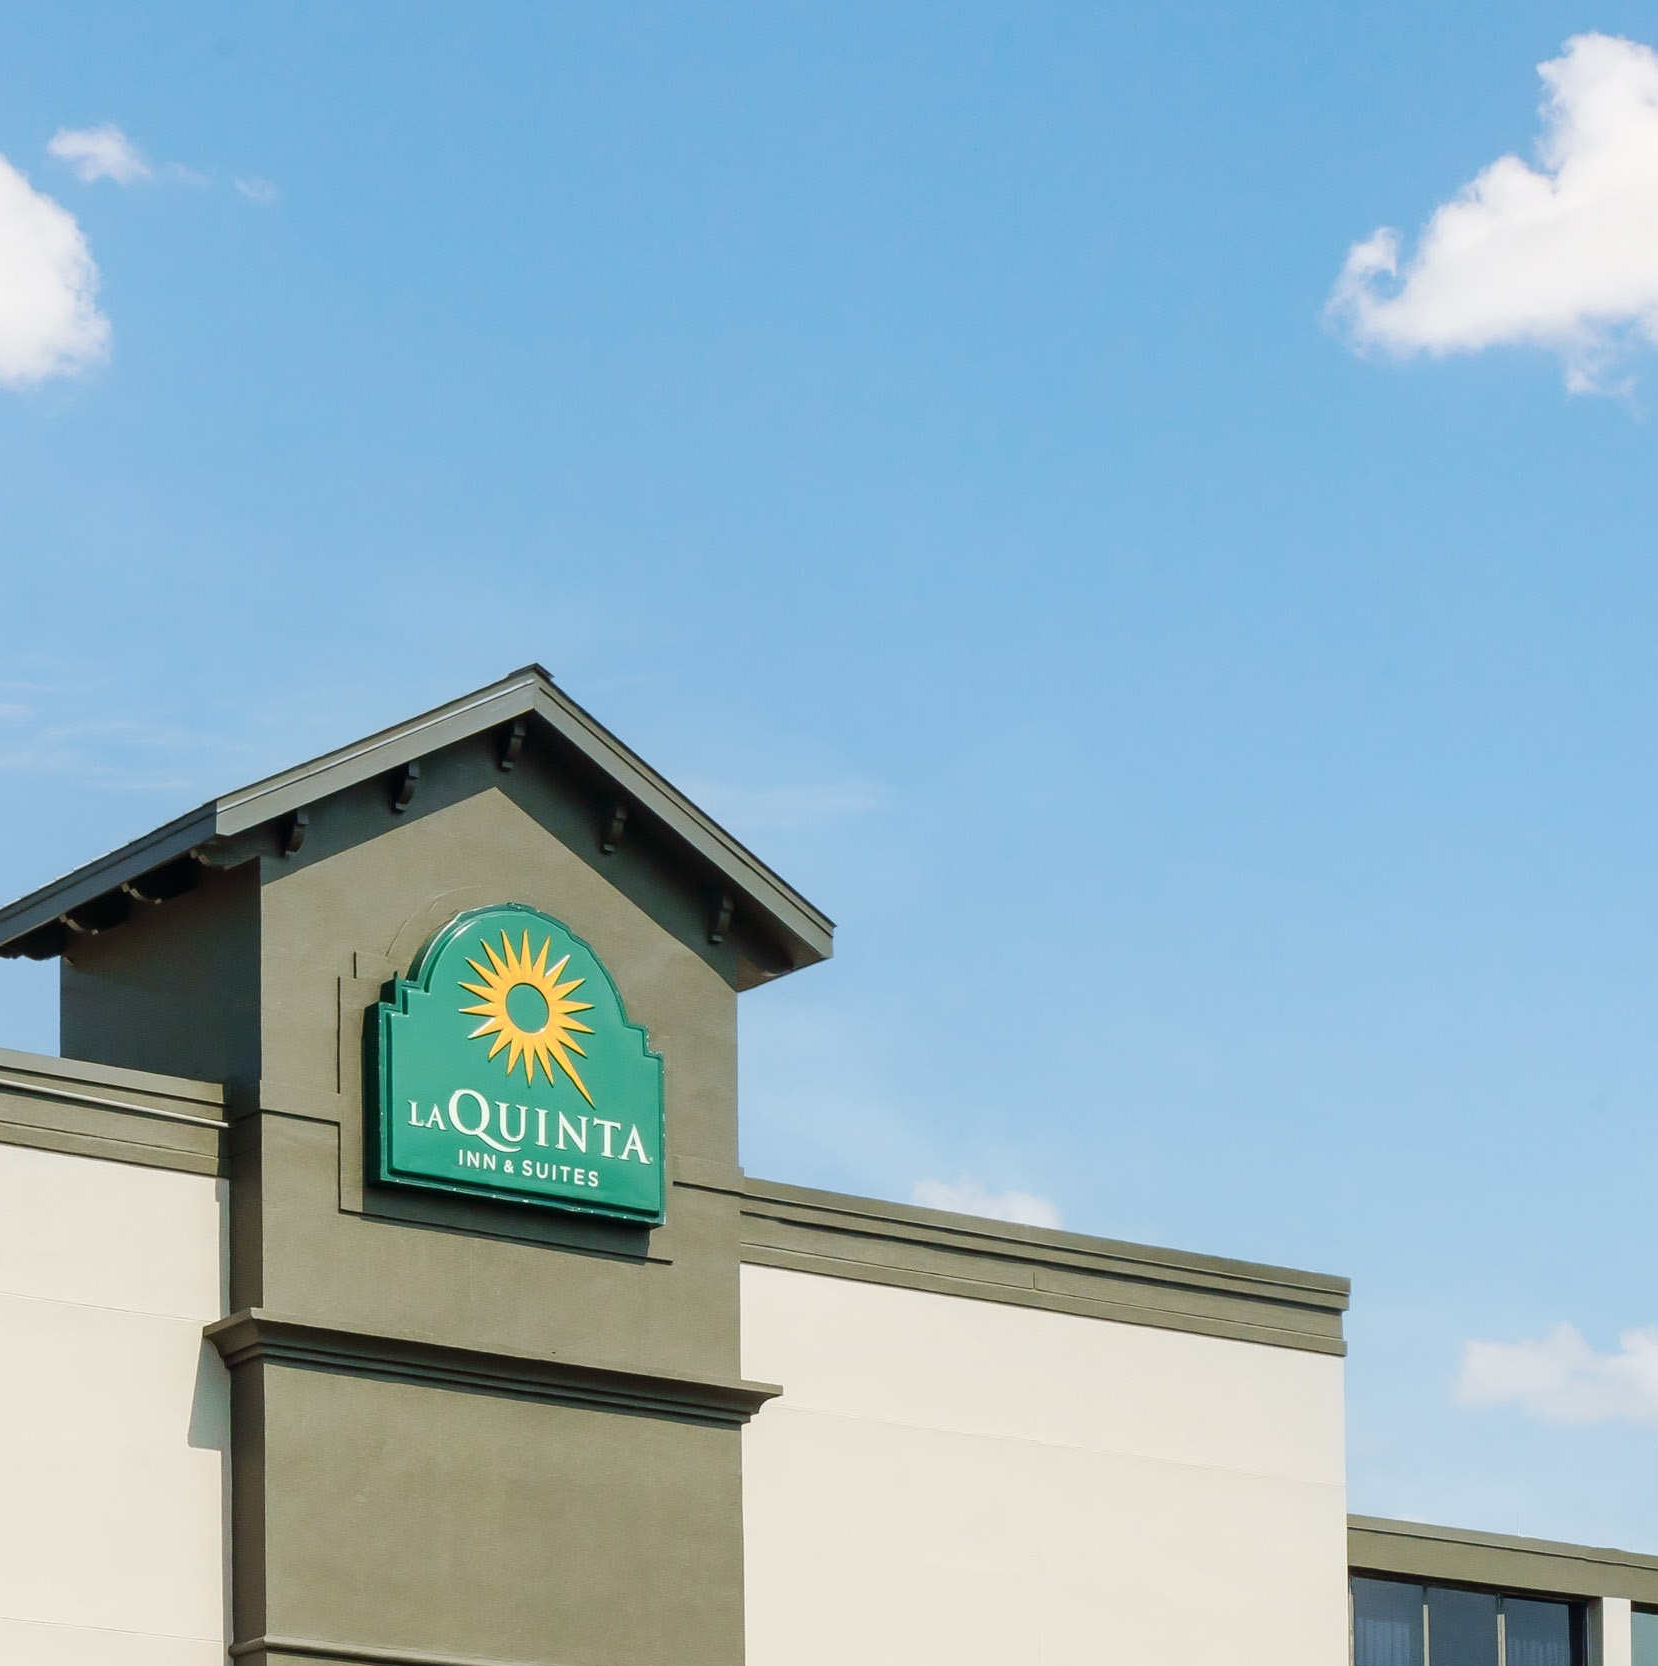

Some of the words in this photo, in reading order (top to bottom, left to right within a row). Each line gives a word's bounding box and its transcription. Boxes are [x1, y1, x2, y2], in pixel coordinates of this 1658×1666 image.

[448, 1088, 651, 1165] QUINTA
[458, 1148, 496, 1171] INN
[503, 1158, 515, 1174] &
[521, 1159, 599, 1188] SUITES
